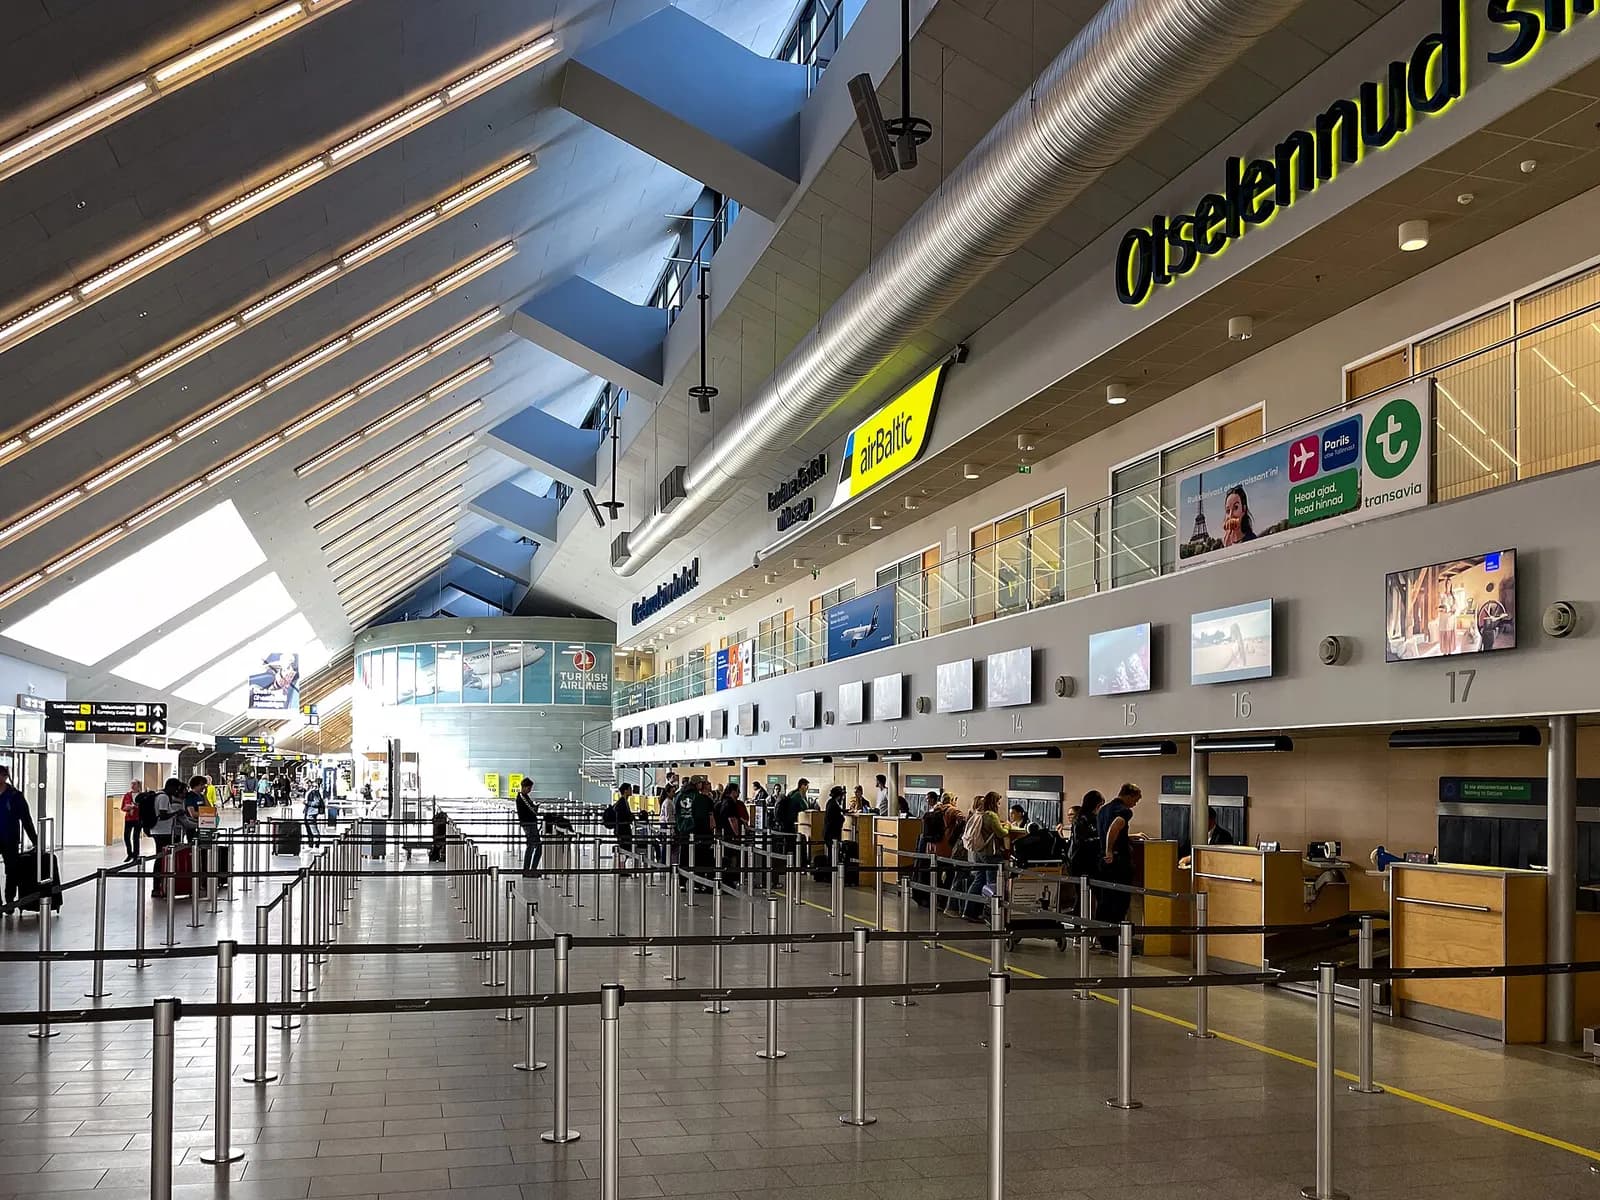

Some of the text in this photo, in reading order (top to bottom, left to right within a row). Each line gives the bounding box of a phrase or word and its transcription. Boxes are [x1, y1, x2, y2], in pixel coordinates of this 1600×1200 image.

[1116, 0, 1464, 304] Otselennud
[860, 412, 913, 474] airBaltic
[1324, 435, 1350, 452] Pariis
[1294, 488, 1316, 504] Head
[1294, 493, 1344, 516] head hinnad
[1364, 483, 1422, 508] transavia
[559, 681, 608, 691] AIRLINES
[560, 671, 608, 682] TURKISH
[1445, 669, 1477, 704] 17
[1122, 703, 1138, 728] 15
[1231, 691, 1252, 719] 16
[958, 719, 968, 737] 13
[1012, 713, 1024, 735] 14
